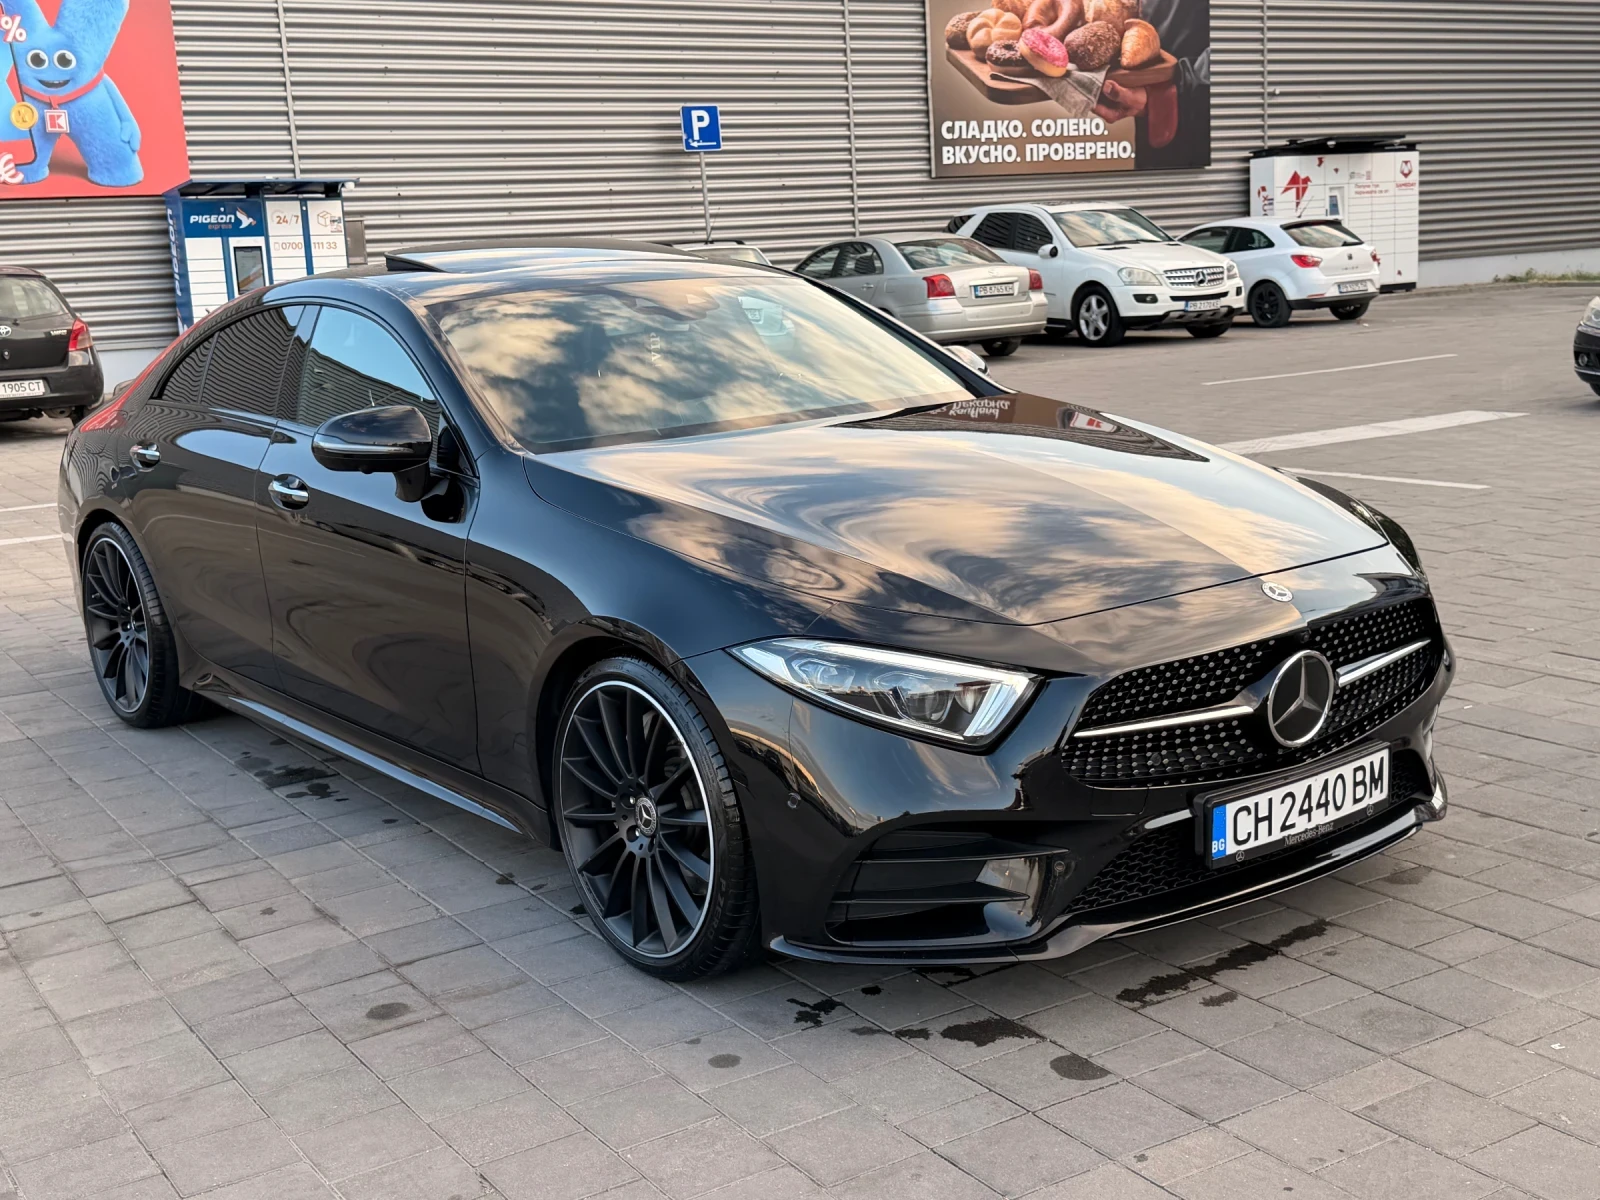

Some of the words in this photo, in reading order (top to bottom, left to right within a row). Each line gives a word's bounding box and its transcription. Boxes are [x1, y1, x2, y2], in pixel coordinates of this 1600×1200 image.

[691, 110, 710, 140] P
[941, 120, 1027, 142] СЛАДКО.
[1031, 118, 1108, 137] СОЛЕНО.
[941, 144, 1021, 164] ВКУСНО.
[1025, 141, 1136, 162] ПРОВЕРЕНО.
[189, 214, 235, 224] PIGEON
[276, 214, 300, 225] 24/7
[167, 207, 182, 297] PIGEON
[281, 241, 303, 250] 0700
[313, 241, 325, 250] 111
[325, 241, 337, 250] 33
[2, 382, 27, 393] 1905
[28, 381, 41, 392] CT
[1233, 797, 1273, 846] CH
[1280, 773, 1346, 833] 2440
[1352, 756, 1384, 805] BM
[1212, 838, 1225, 853] BG
[1284, 821, 1334, 847] Mercedes-Benz
